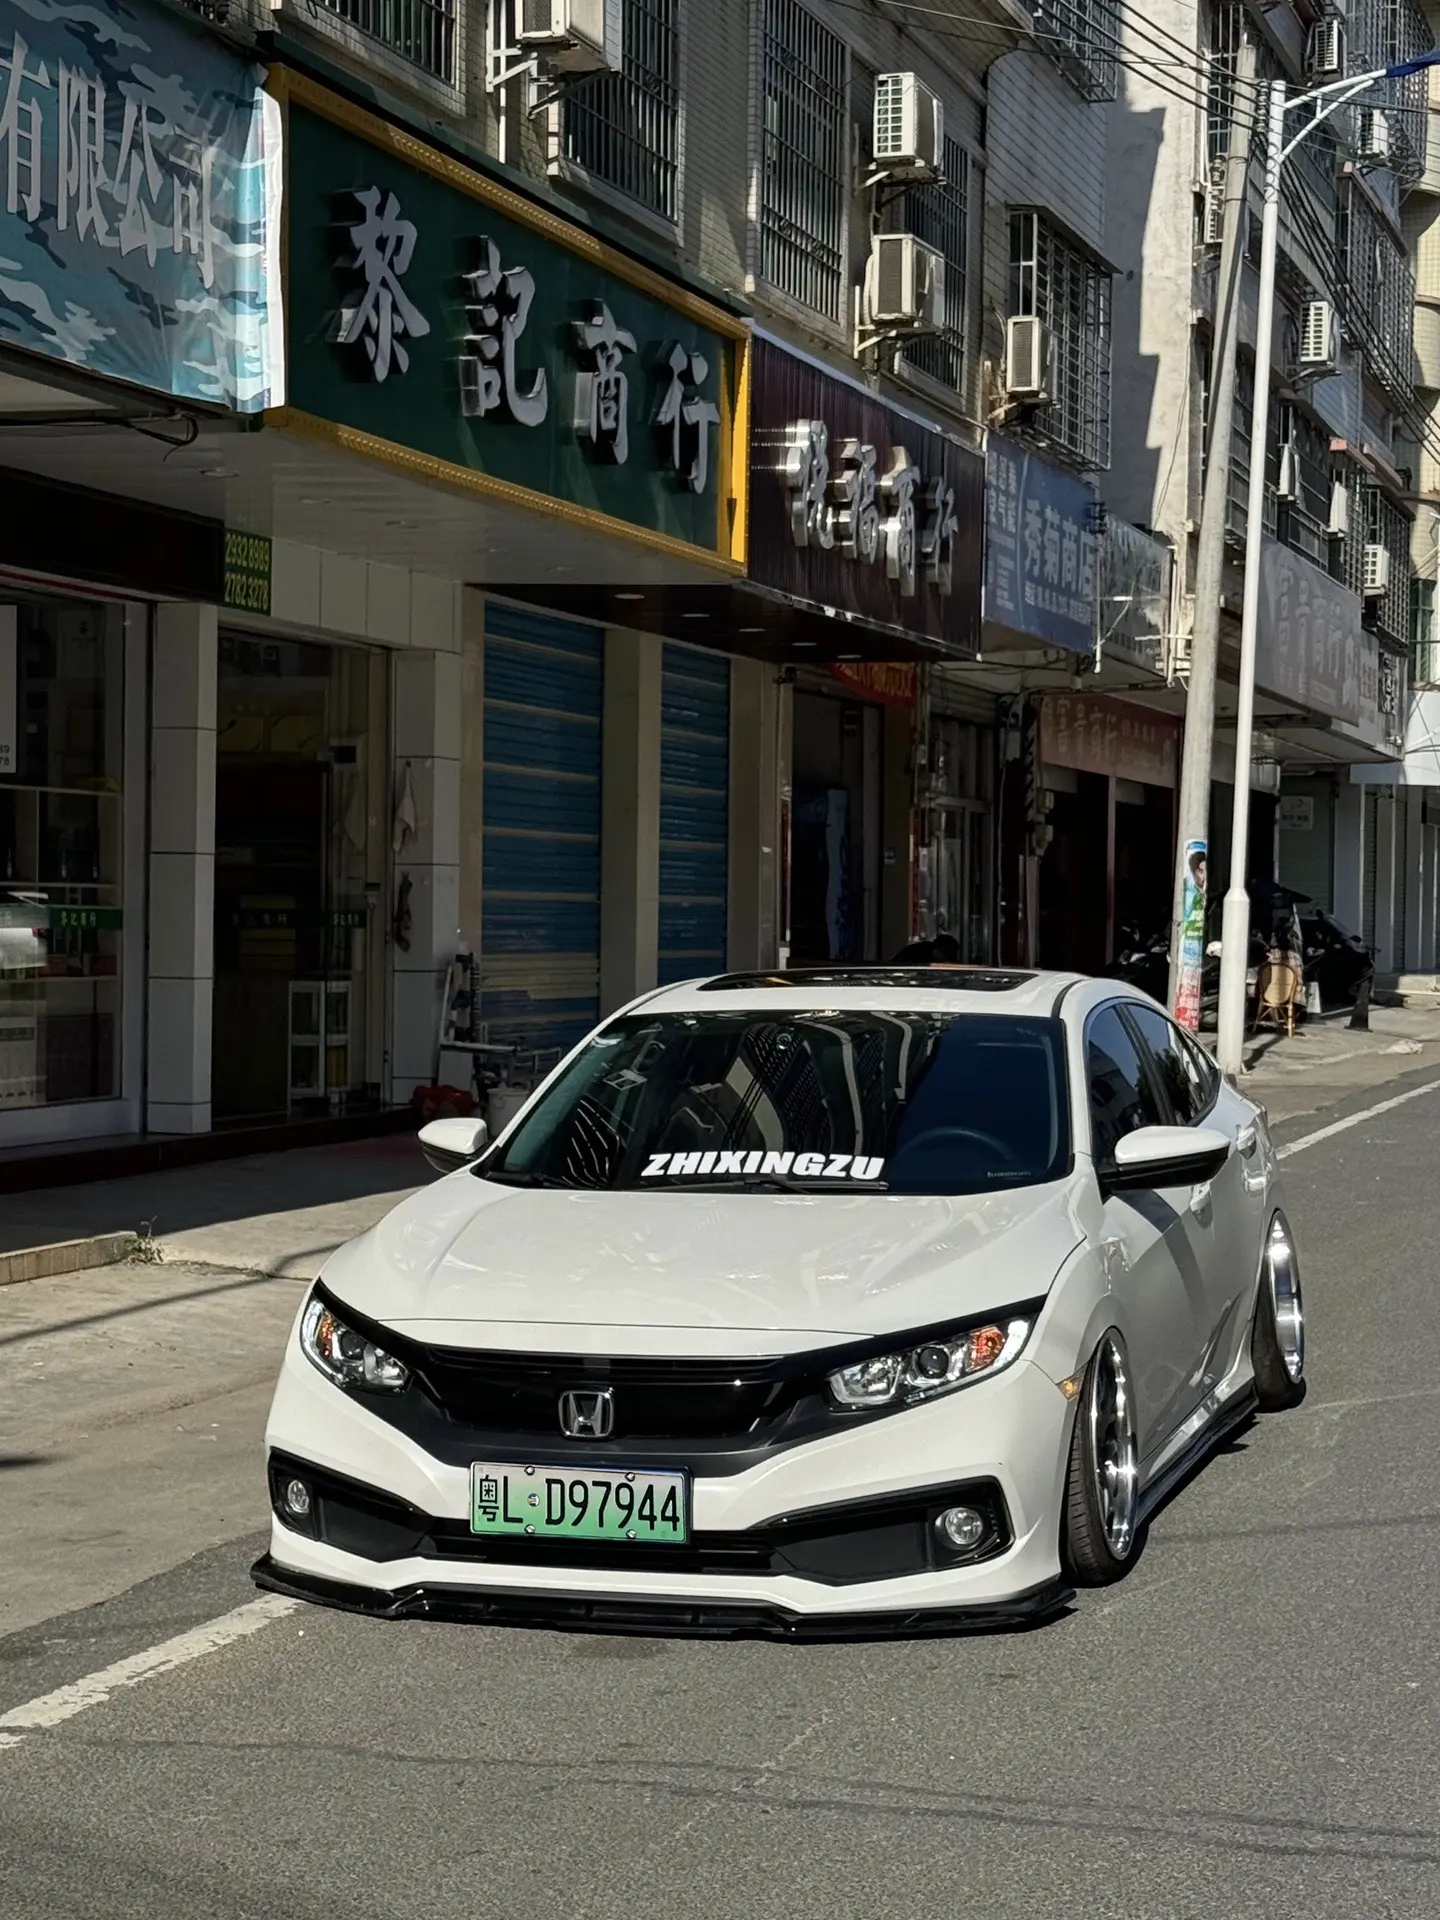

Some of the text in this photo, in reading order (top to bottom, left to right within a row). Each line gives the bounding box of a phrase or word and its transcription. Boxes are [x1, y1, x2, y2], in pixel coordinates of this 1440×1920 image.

[0, 31, 214, 288] 有限公司
[338, 186, 719, 496] 黎記商行
[225, 532, 269, 572] 29328989
[224, 572, 268, 610] 27823278
[641, 1151, 885, 1180] ZHIXINGZU
[545, 1478, 680, 1531] D97944
